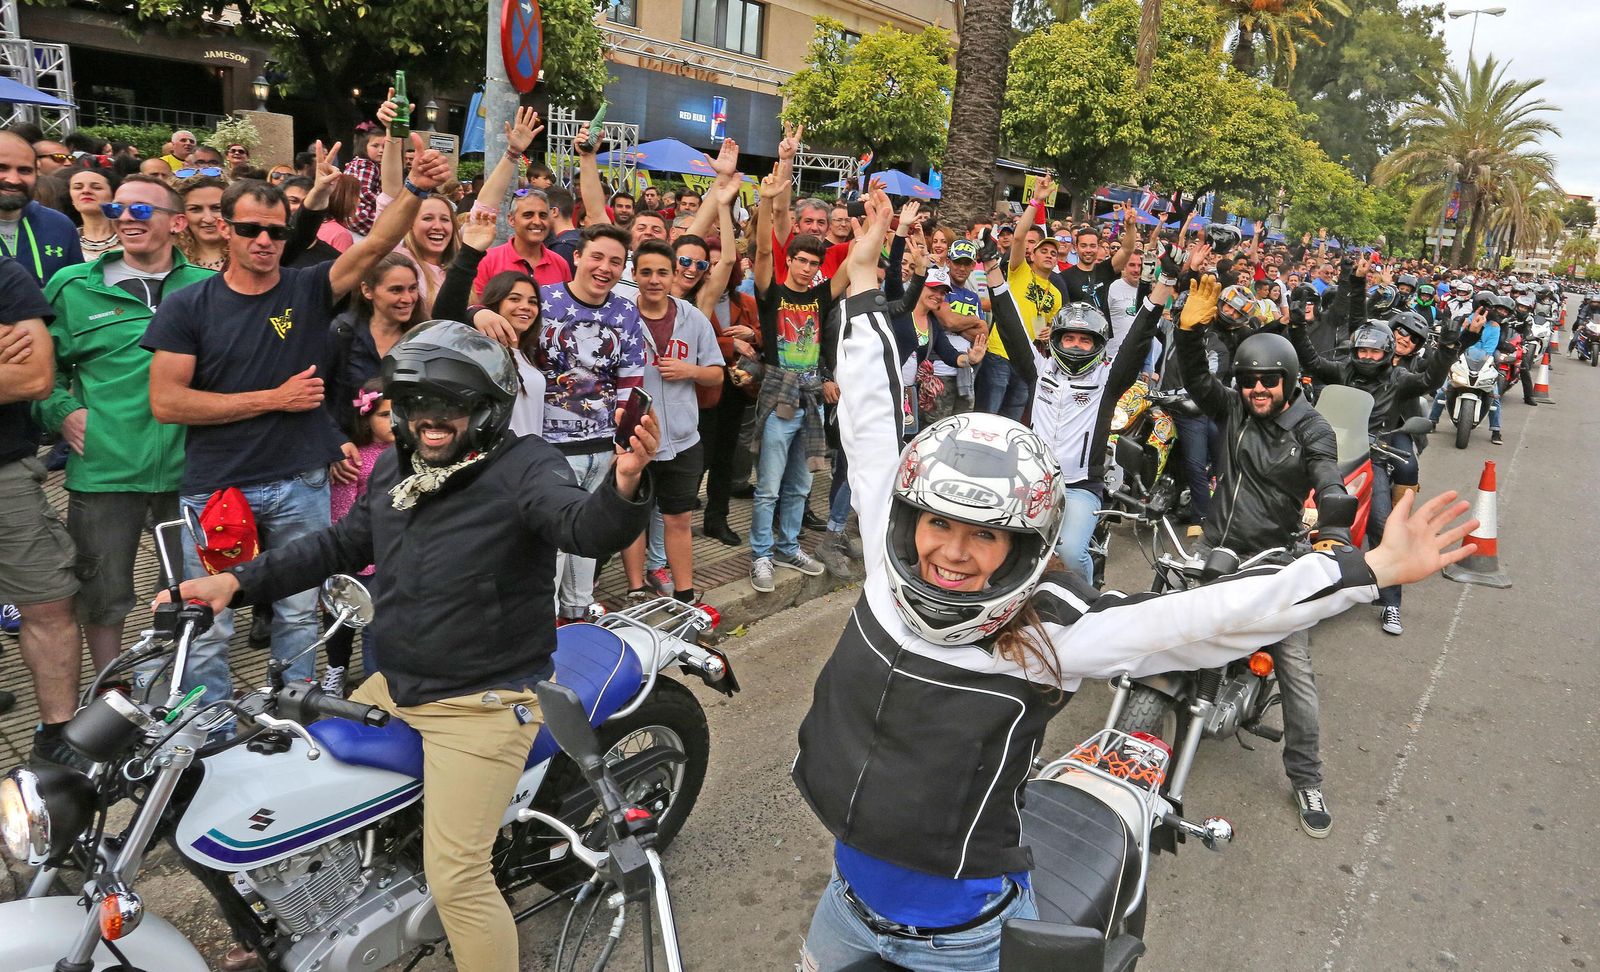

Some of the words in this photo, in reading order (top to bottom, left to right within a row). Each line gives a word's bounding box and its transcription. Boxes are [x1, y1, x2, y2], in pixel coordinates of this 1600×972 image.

[204, 50, 250, 64] JAMESON
[679, 110, 692, 120] RED
[692, 112, 707, 123] BULL
[955, 242, 974, 252] 46
[949, 300, 978, 316] 46
[939, 482, 995, 504] HJC
